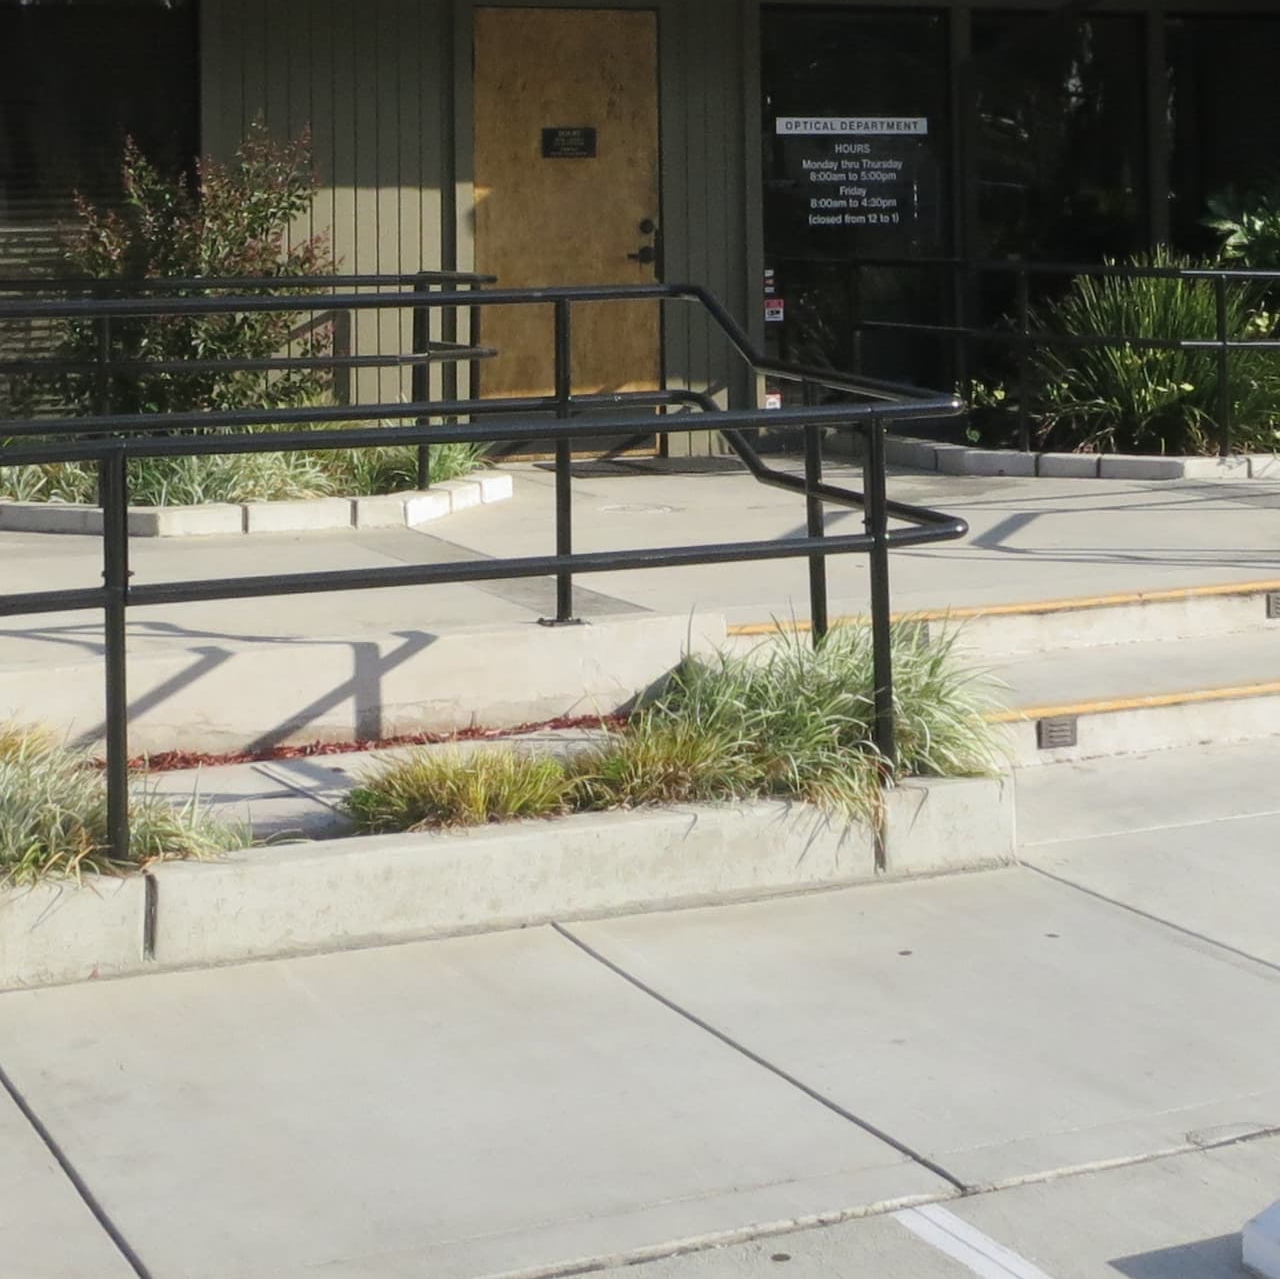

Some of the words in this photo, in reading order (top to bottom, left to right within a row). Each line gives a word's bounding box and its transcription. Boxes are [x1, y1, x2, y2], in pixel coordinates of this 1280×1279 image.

[784, 120, 836, 131] OPTICAL
[840, 120, 920, 131] DEPARTMENT
[834, 143, 871, 154] HOURS
[802, 159, 838, 171] Monday
[840, 159, 860, 169] thru
[862, 159, 904, 170] Thursday
[848, 171, 858, 181] to
[839, 186, 868, 197] Friday
[849, 197, 859, 208] to
[808, 213, 843, 226] (closed
[844, 214, 865, 224] from
[879, 214, 890, 224] to
